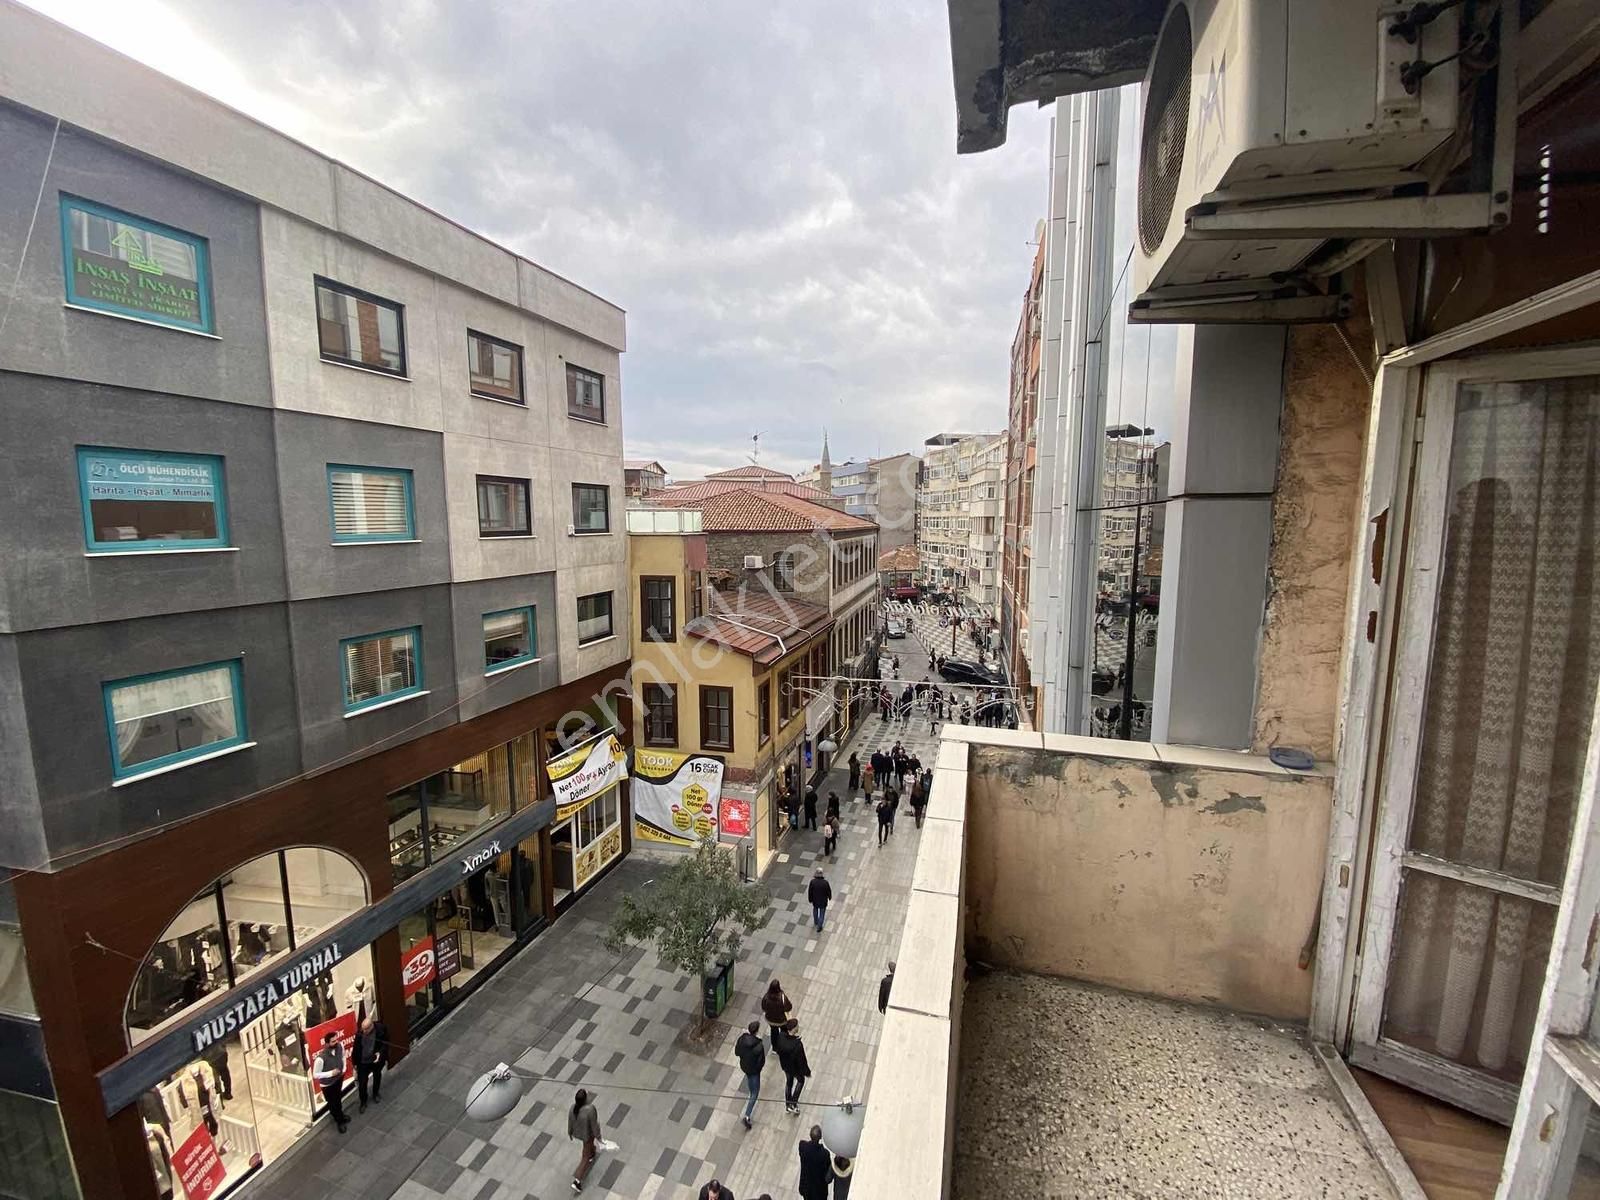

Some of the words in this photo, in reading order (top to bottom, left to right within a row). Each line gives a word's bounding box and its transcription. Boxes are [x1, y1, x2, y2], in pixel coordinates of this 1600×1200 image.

[120, 462, 145, 477] ÖLÇÜ
[146, 464, 209, 478] MÜHENDİSLİK
[558, 781, 573, 794] Net
[572, 772, 586, 786] 100
[597, 761, 616, 777] Ayran
[689, 762, 702, 773] 16
[570, 783, 591, 801] Döner
[461, 840, 501, 874] Xmark
[196, 983, 280, 1051] MUSTAFA
[280, 943, 342, 999] TURHAL
